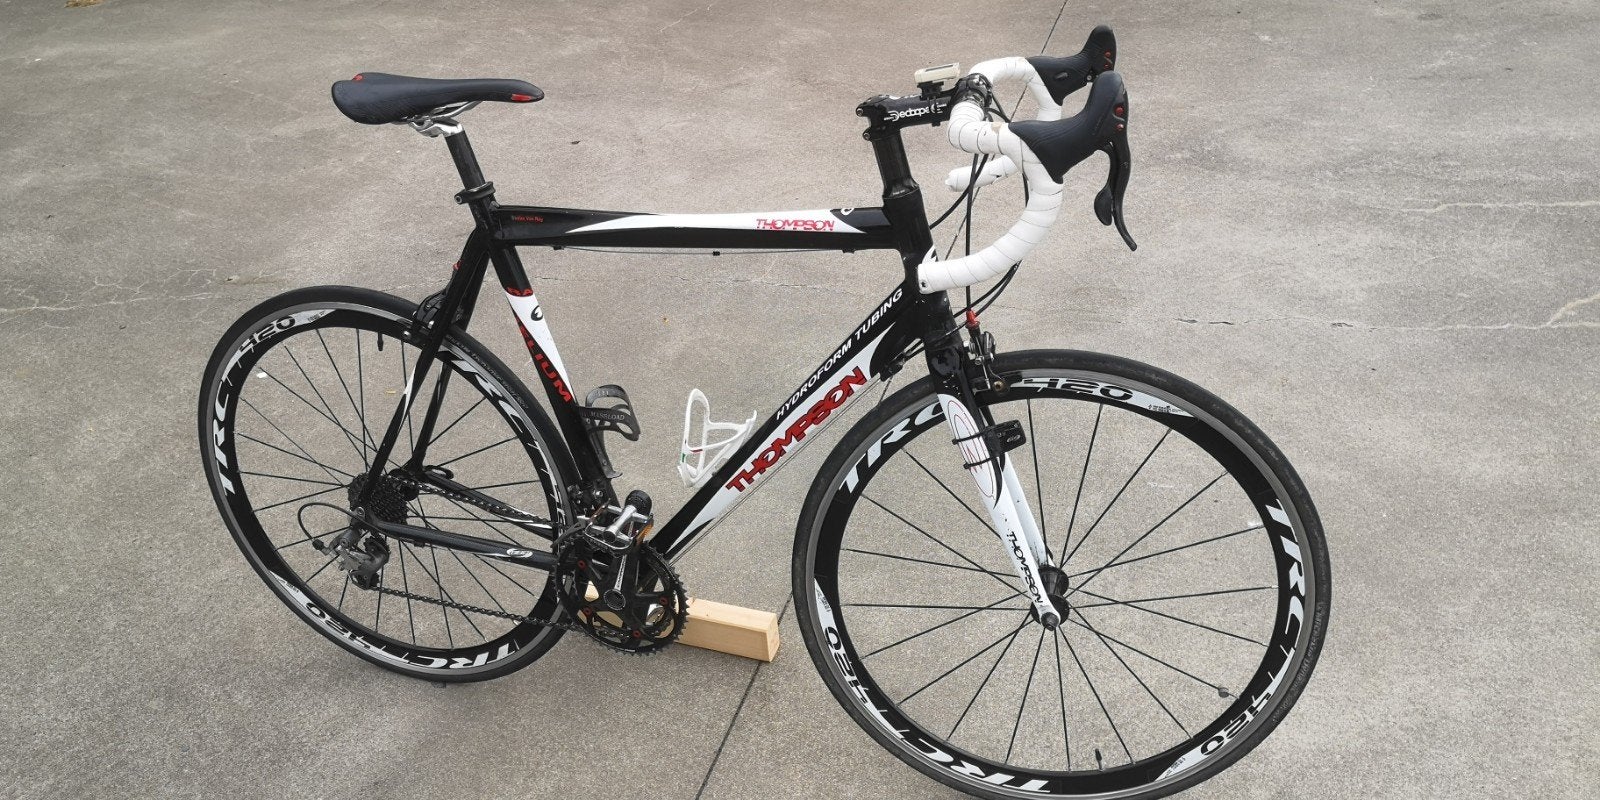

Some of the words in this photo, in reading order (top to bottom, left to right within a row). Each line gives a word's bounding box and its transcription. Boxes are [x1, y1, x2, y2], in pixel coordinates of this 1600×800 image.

[756, 219, 834, 230] THOMPSON
[776, 338, 852, 420] HYDROFORM
[854, 288, 903, 340] TUBING
[213, 381, 236, 496] TRC
[725, 366, 868, 492] THOMPSON
[839, 402, 944, 494] TRC
[1006, 531, 1043, 603] THOMPSON
[1265, 498, 1306, 649] TRC
[408, 644, 516, 669] TRC
[901, 737, 1051, 794] TRC
